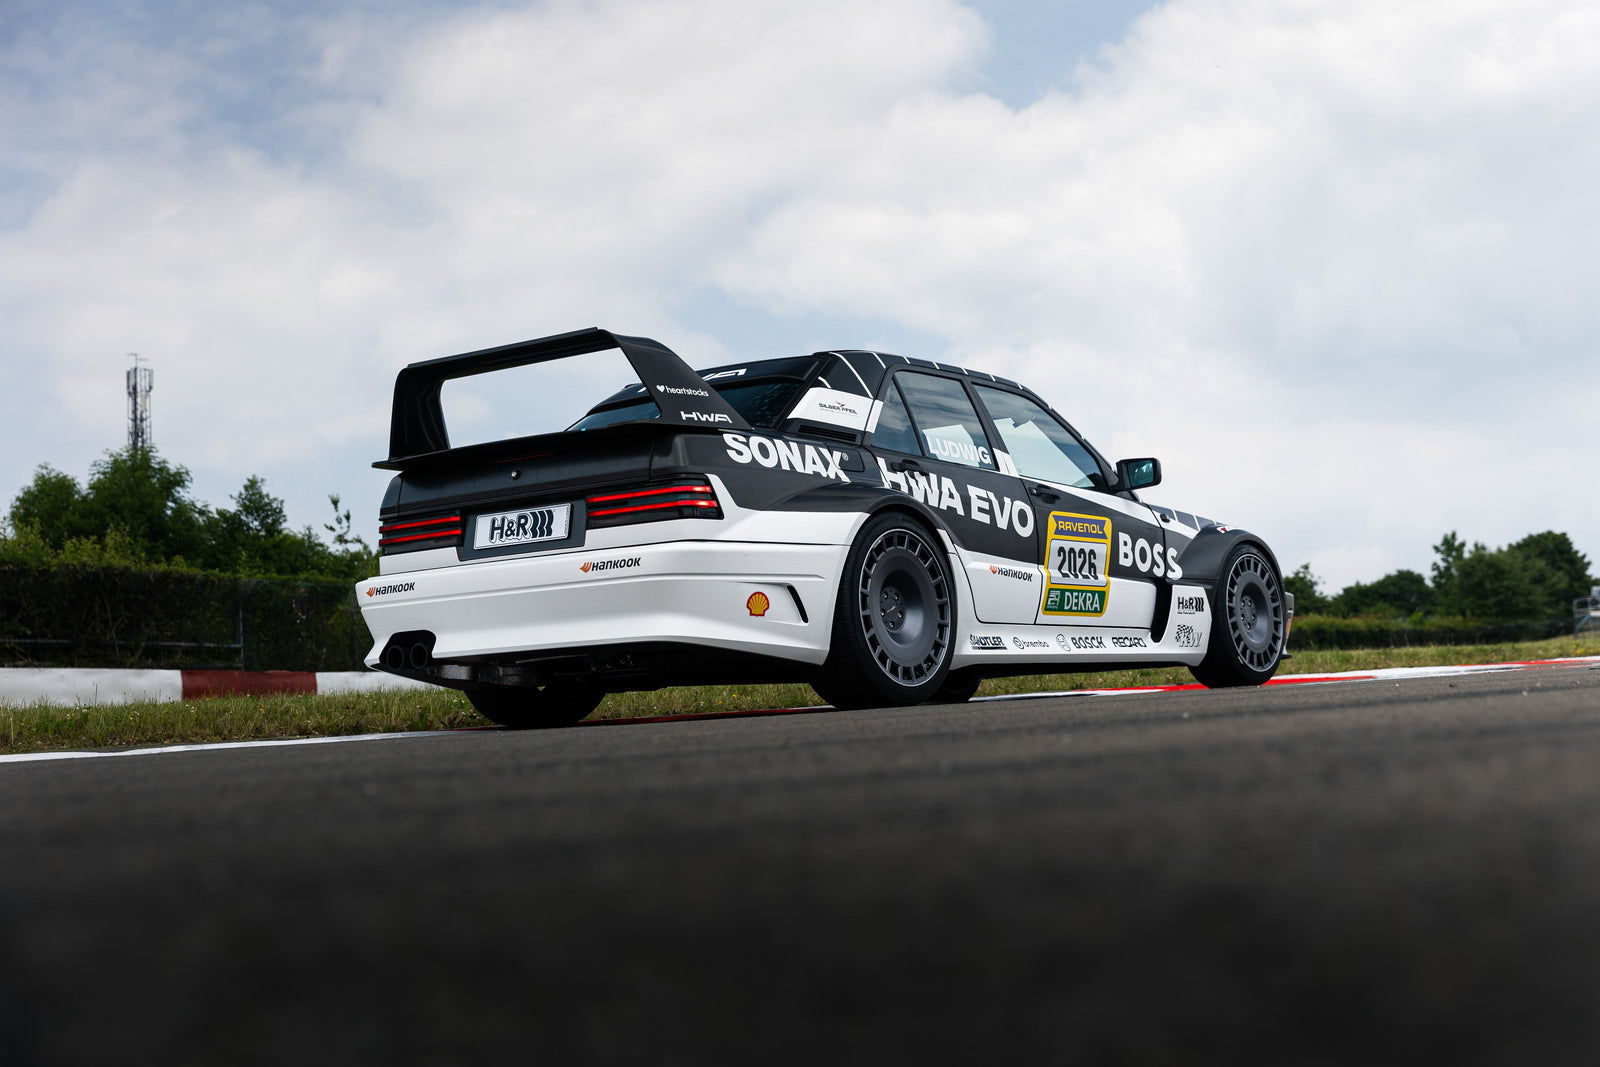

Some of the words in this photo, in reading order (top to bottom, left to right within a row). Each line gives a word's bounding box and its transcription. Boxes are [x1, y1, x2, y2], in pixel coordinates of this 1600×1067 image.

[666, 385, 709, 397] heartstocks
[680, 411, 733, 424] HWA
[722, 433, 851, 483] SONAX
[927, 436, 992, 465] LUDWIG
[876, 456, 965, 516] HWA
[967, 484, 1035, 538] EVO
[490, 513, 532, 543] H&R
[1058, 520, 1103, 534] RAVENOL
[1057, 546, 1099, 580] 2026
[1118, 531, 1183, 581] BOSS
[1063, 591, 1101, 611] DEKRA
[1021, 638, 1050, 648] brembo
[1071, 636, 1107, 649] BOSCH
[1112, 636, 1147, 648] RECARO
